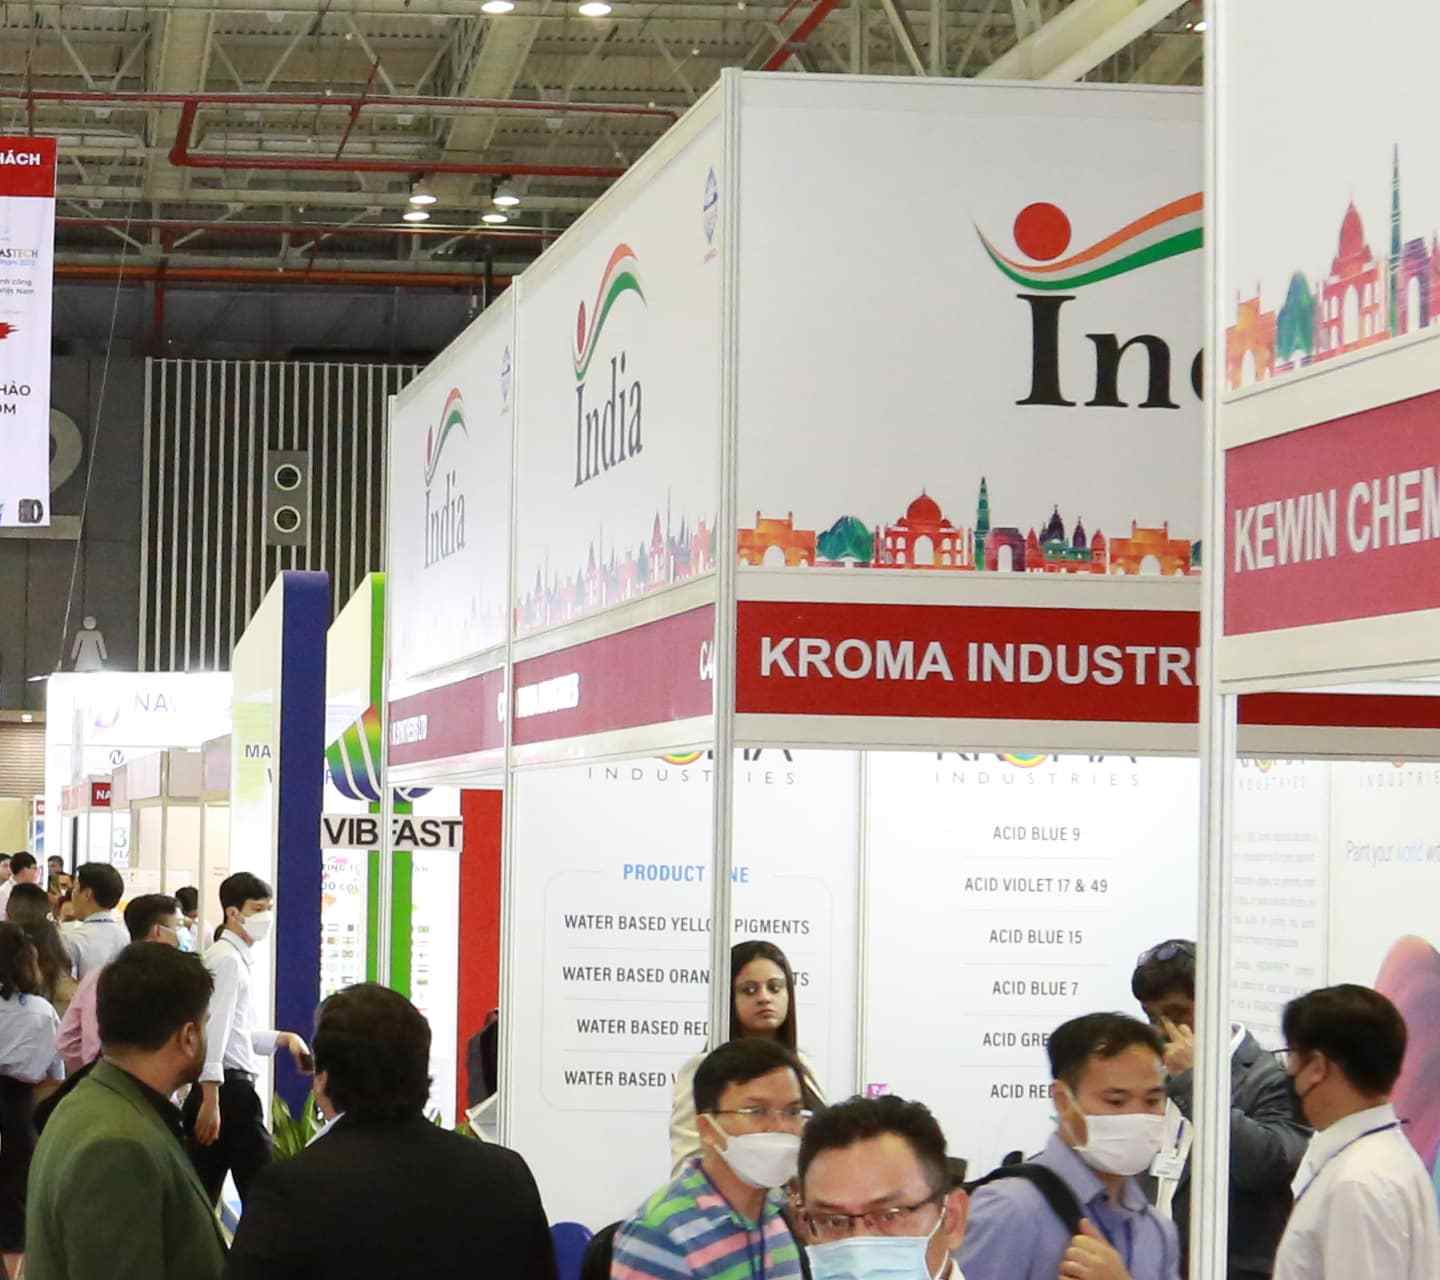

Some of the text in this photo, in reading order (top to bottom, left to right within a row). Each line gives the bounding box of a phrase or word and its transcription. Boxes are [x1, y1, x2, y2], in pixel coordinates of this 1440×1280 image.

[573, 351, 643, 488] India
[424, 470, 466, 570] India
[1233, 486, 1337, 574] KEWIN
[760, 636, 949, 684] KROMA
[992, 826, 1080, 841] ACID BLUE 9
[623, 864, 705, 882] PRODUCT
[964, 877, 1108, 893] ACID VIOLET 17 & 49
[564, 915, 810, 935] WATER BASED PIGMENTS
[989, 929, 1082, 944] ACID BLUE 15
[562, 966, 664, 983] WATER BASED
[992, 981, 1078, 996] ACID BLUE 7
[577, 1019, 678, 1035] WATER BASED
[983, 1033, 1016, 1047] ACID
[564, 1071, 666, 1088] WATER BASED
[991, 1084, 1024, 1098] ACID
